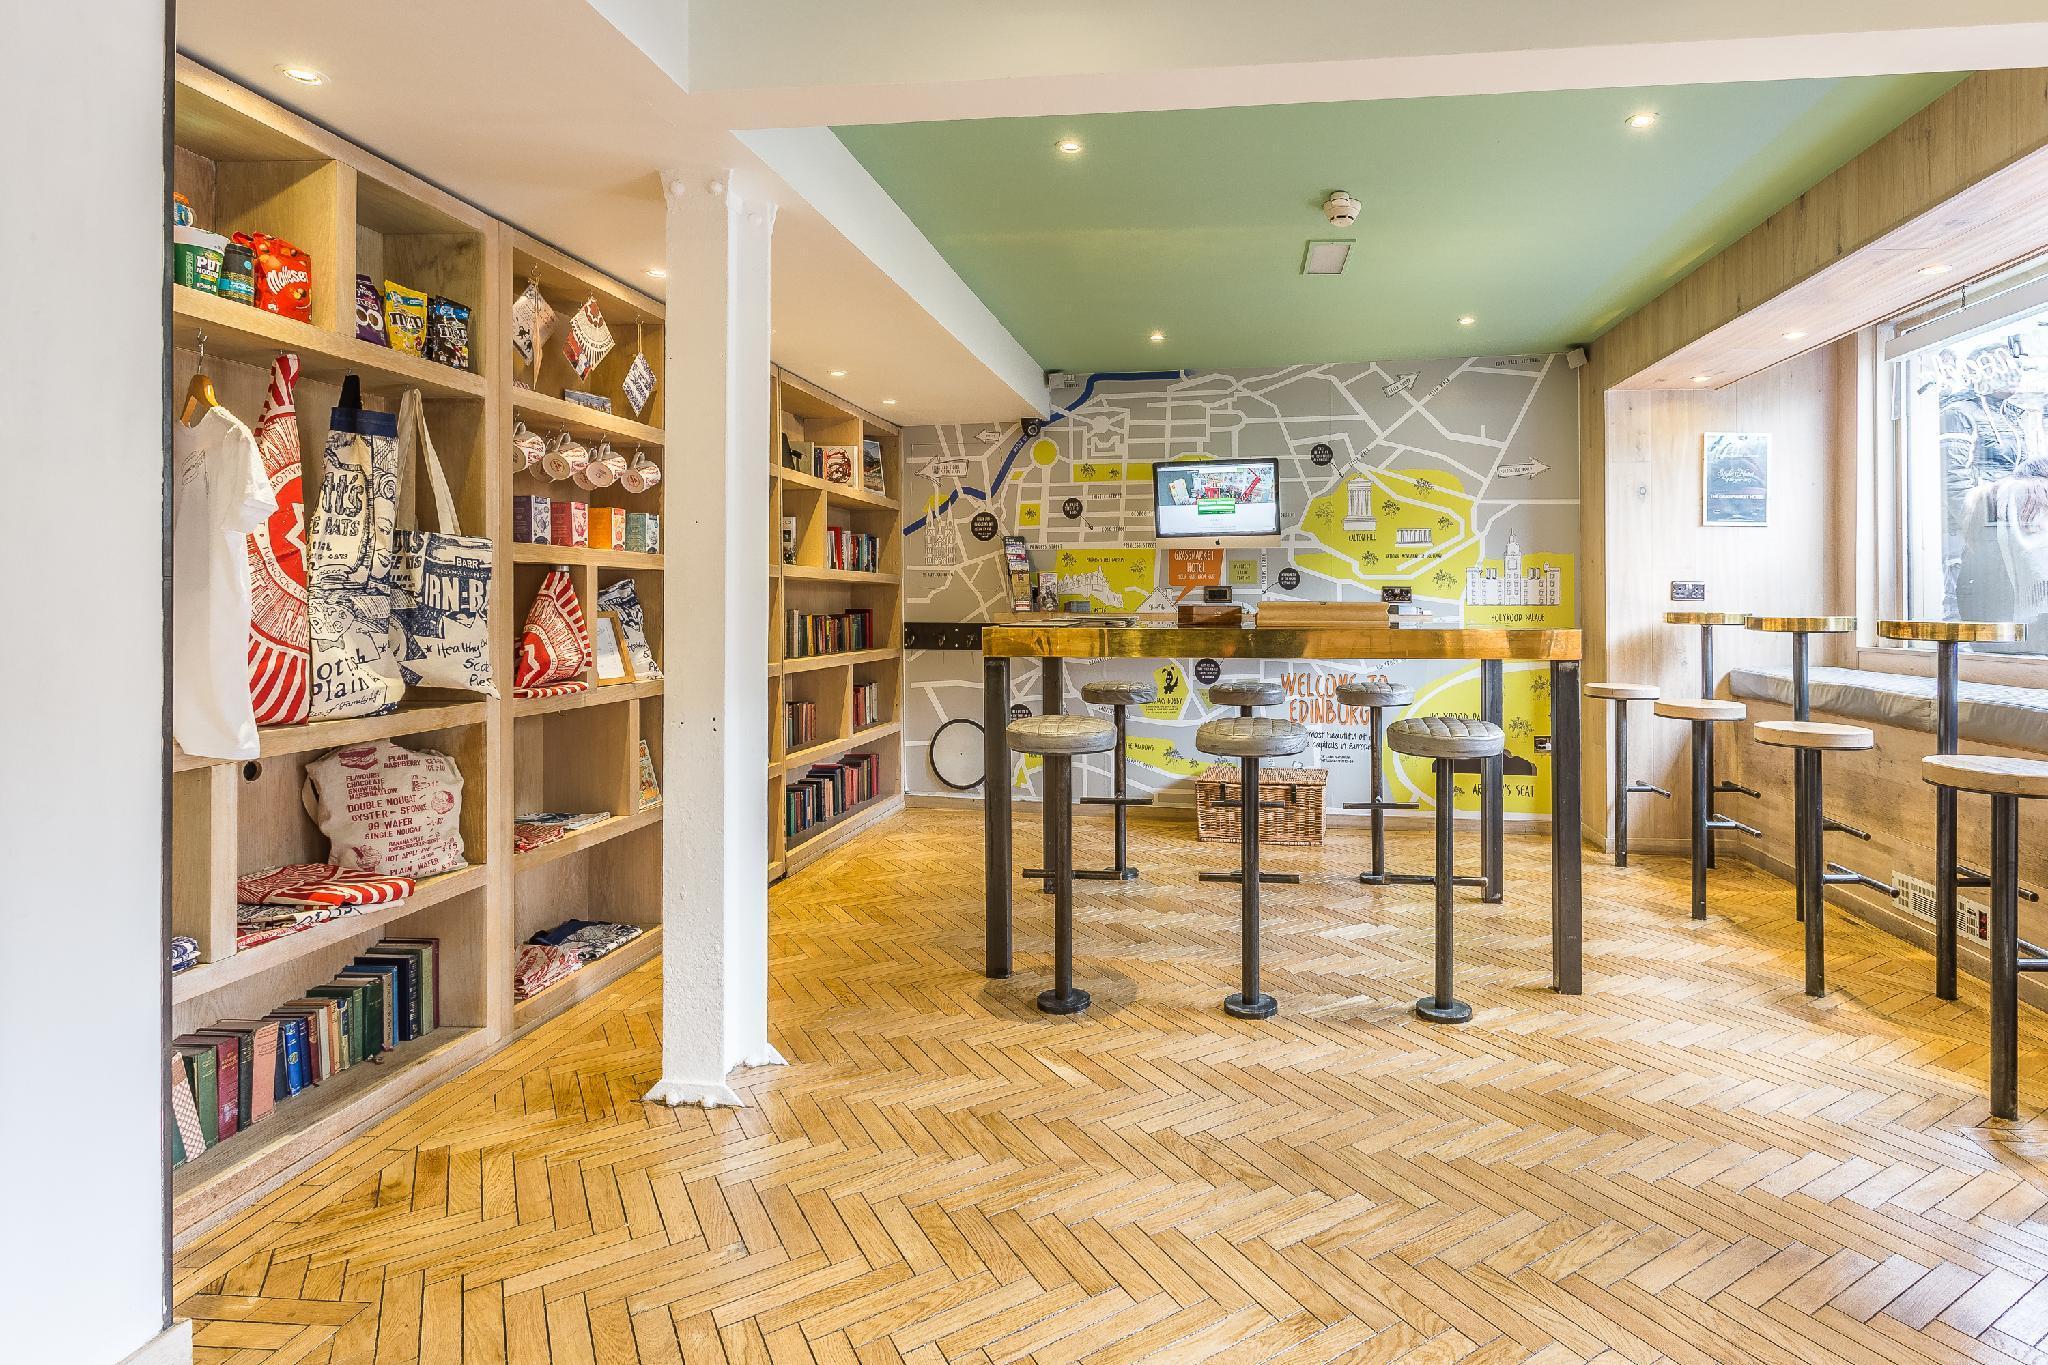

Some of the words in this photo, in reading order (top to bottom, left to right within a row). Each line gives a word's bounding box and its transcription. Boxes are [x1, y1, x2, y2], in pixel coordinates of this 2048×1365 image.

[456, 557, 479, 569] BARR
[1187, 562, 1206, 573] HOTEL
[384, 760, 421, 769] RASPBERRY
[388, 754, 408, 763] PLAIN
[346, 777, 385, 789] CHOCOLATE
[1515, 784, 1534, 798] SEAT
[347, 800, 383, 813] DOUBLE
[386, 794, 416, 806] NOUGAT
[352, 809, 389, 822] OYSTER
[368, 821, 380, 831] 99
[384, 817, 413, 830] WAFER
[365, 831, 393, 840] SINGLE
[396, 826, 422, 836] NOUGAT
[389, 866, 413, 876] PLAIN
[418, 858, 440, 870] WAFER
